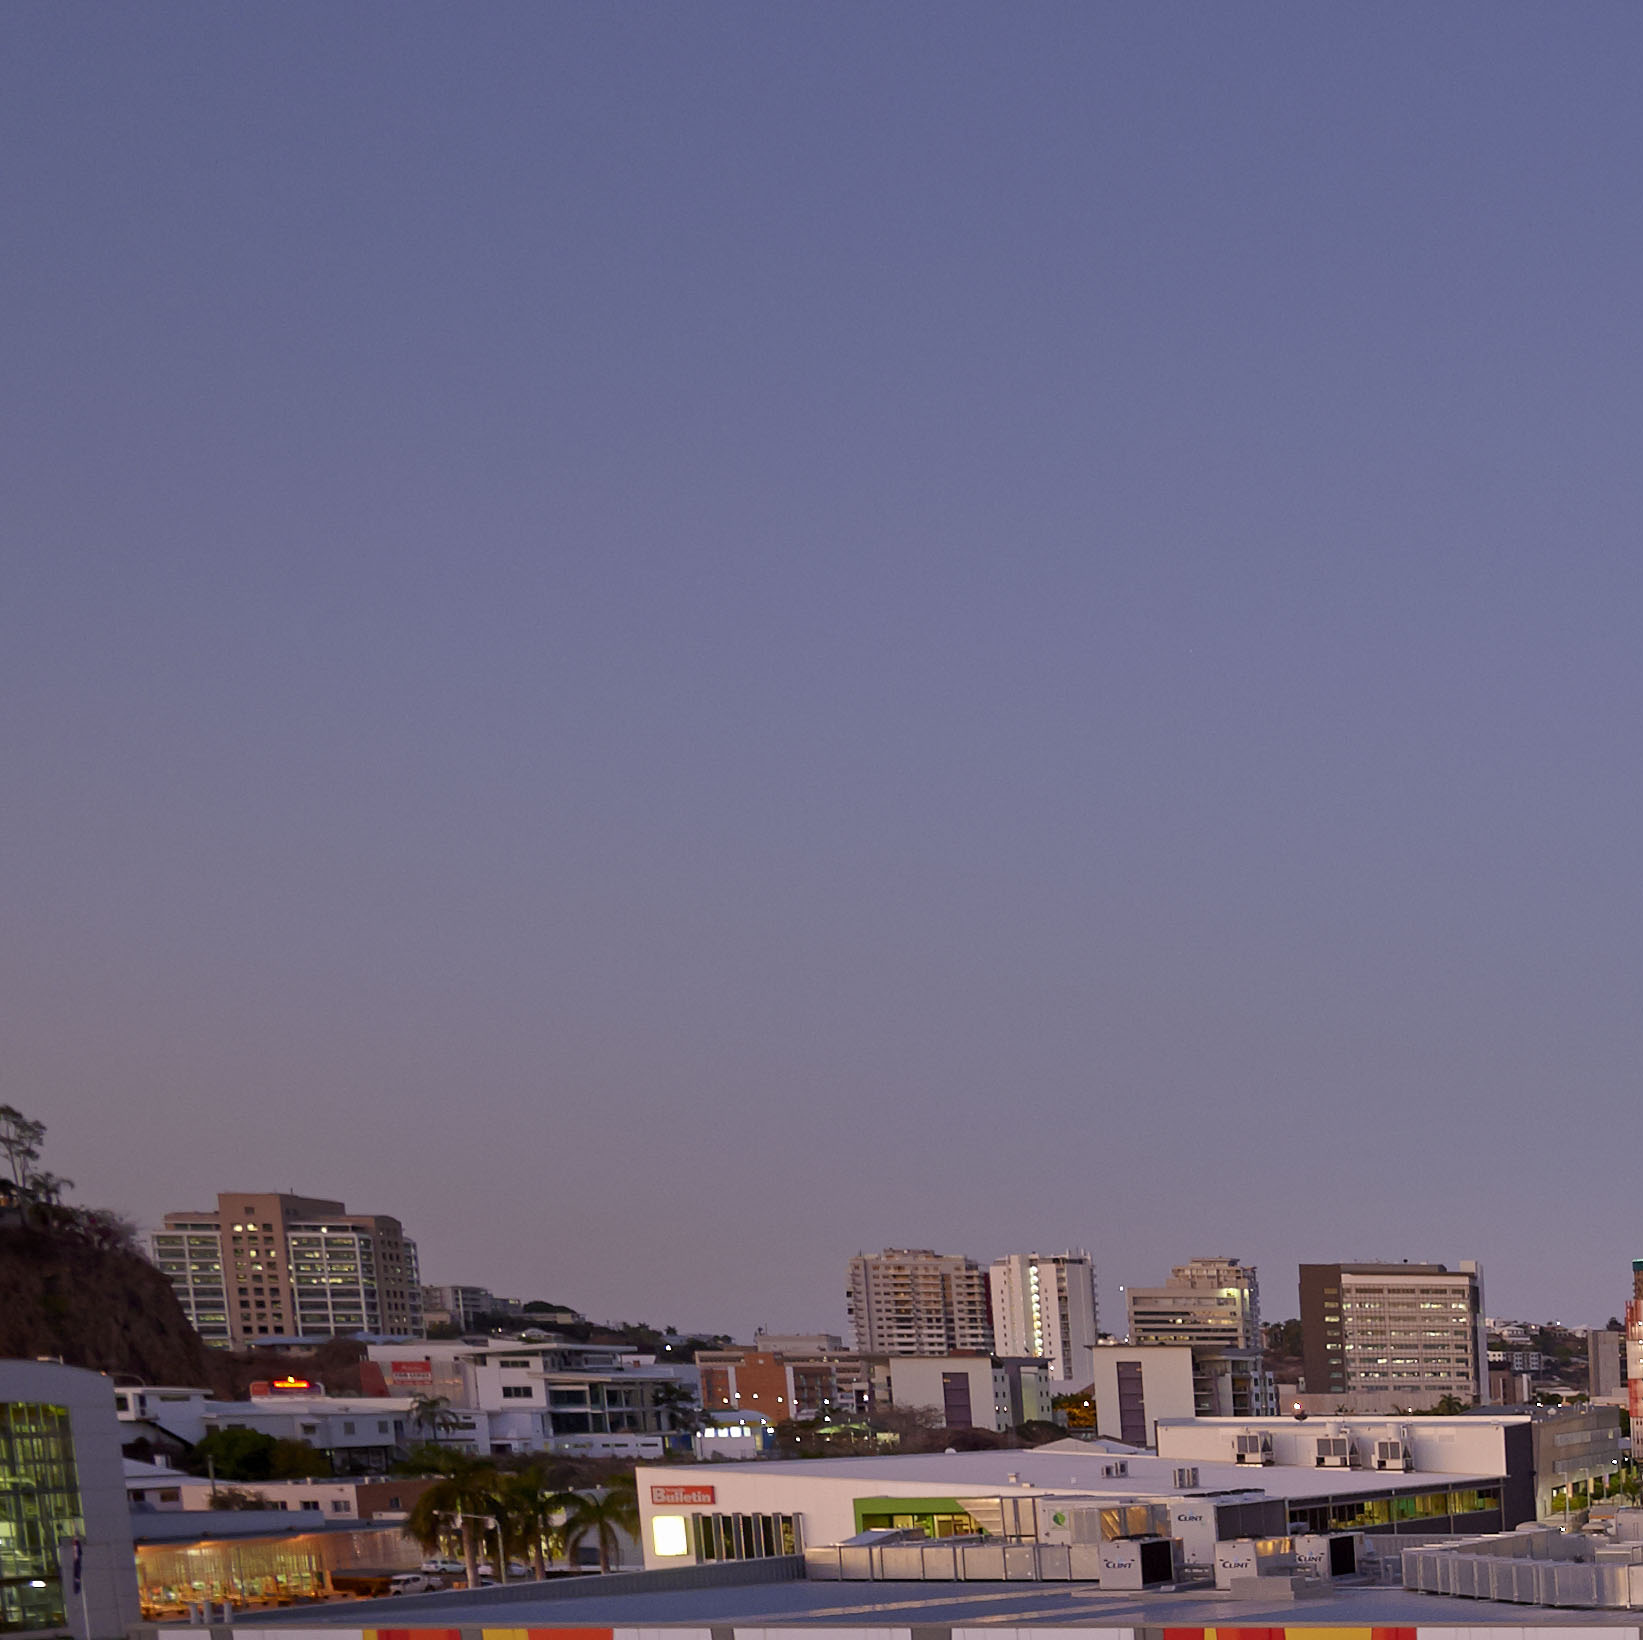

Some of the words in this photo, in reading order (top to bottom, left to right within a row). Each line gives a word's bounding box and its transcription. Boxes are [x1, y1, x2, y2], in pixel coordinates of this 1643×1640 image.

[652, 1488, 711, 1503] Bulletin
[1297, 1555, 1324, 1563] CLINT
[1106, 1561, 1132, 1569] CLINT
[1222, 1561, 1250, 1569] CLINT
